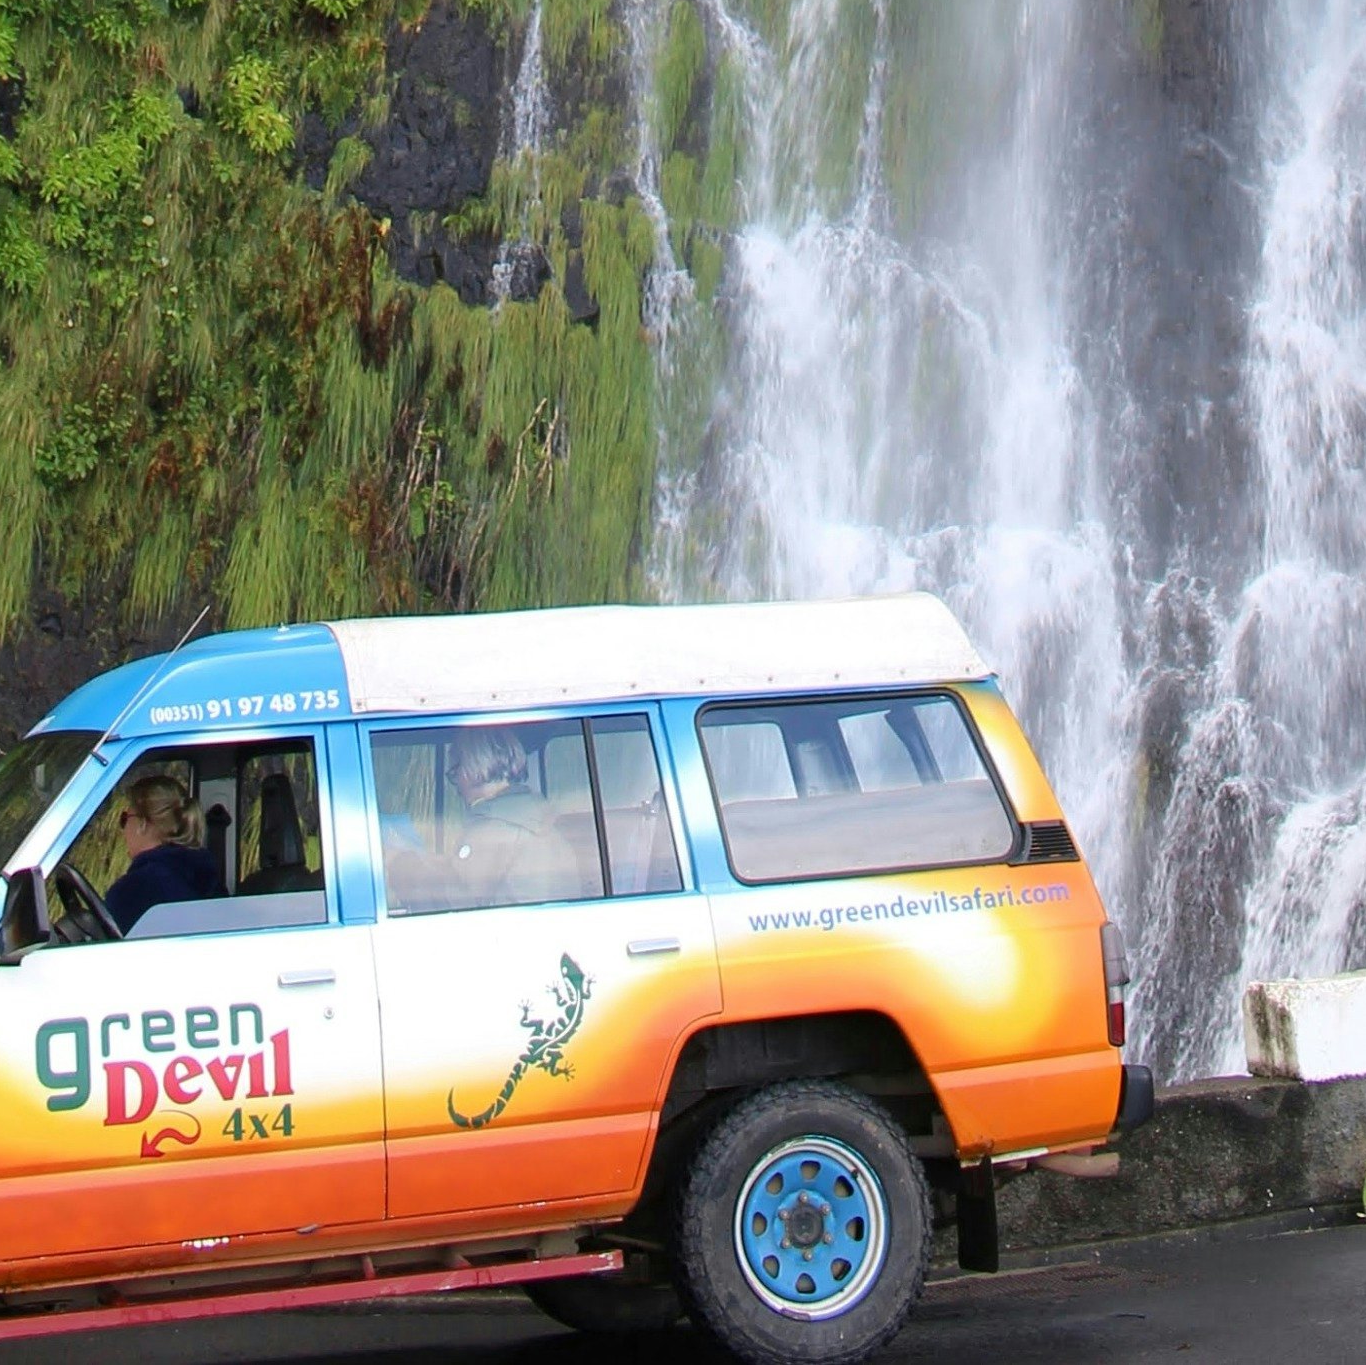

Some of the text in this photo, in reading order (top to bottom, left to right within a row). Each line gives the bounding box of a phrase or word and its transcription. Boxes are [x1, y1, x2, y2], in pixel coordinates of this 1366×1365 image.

[150, 689, 340, 725] (00351) 91 97 48 735
[748, 883, 1069, 931] www.greendevilsafari.com
[35, 1002, 264, 1112] green
[103, 1028, 294, 1126] Devil
[222, 1103, 295, 1142] 4x4
